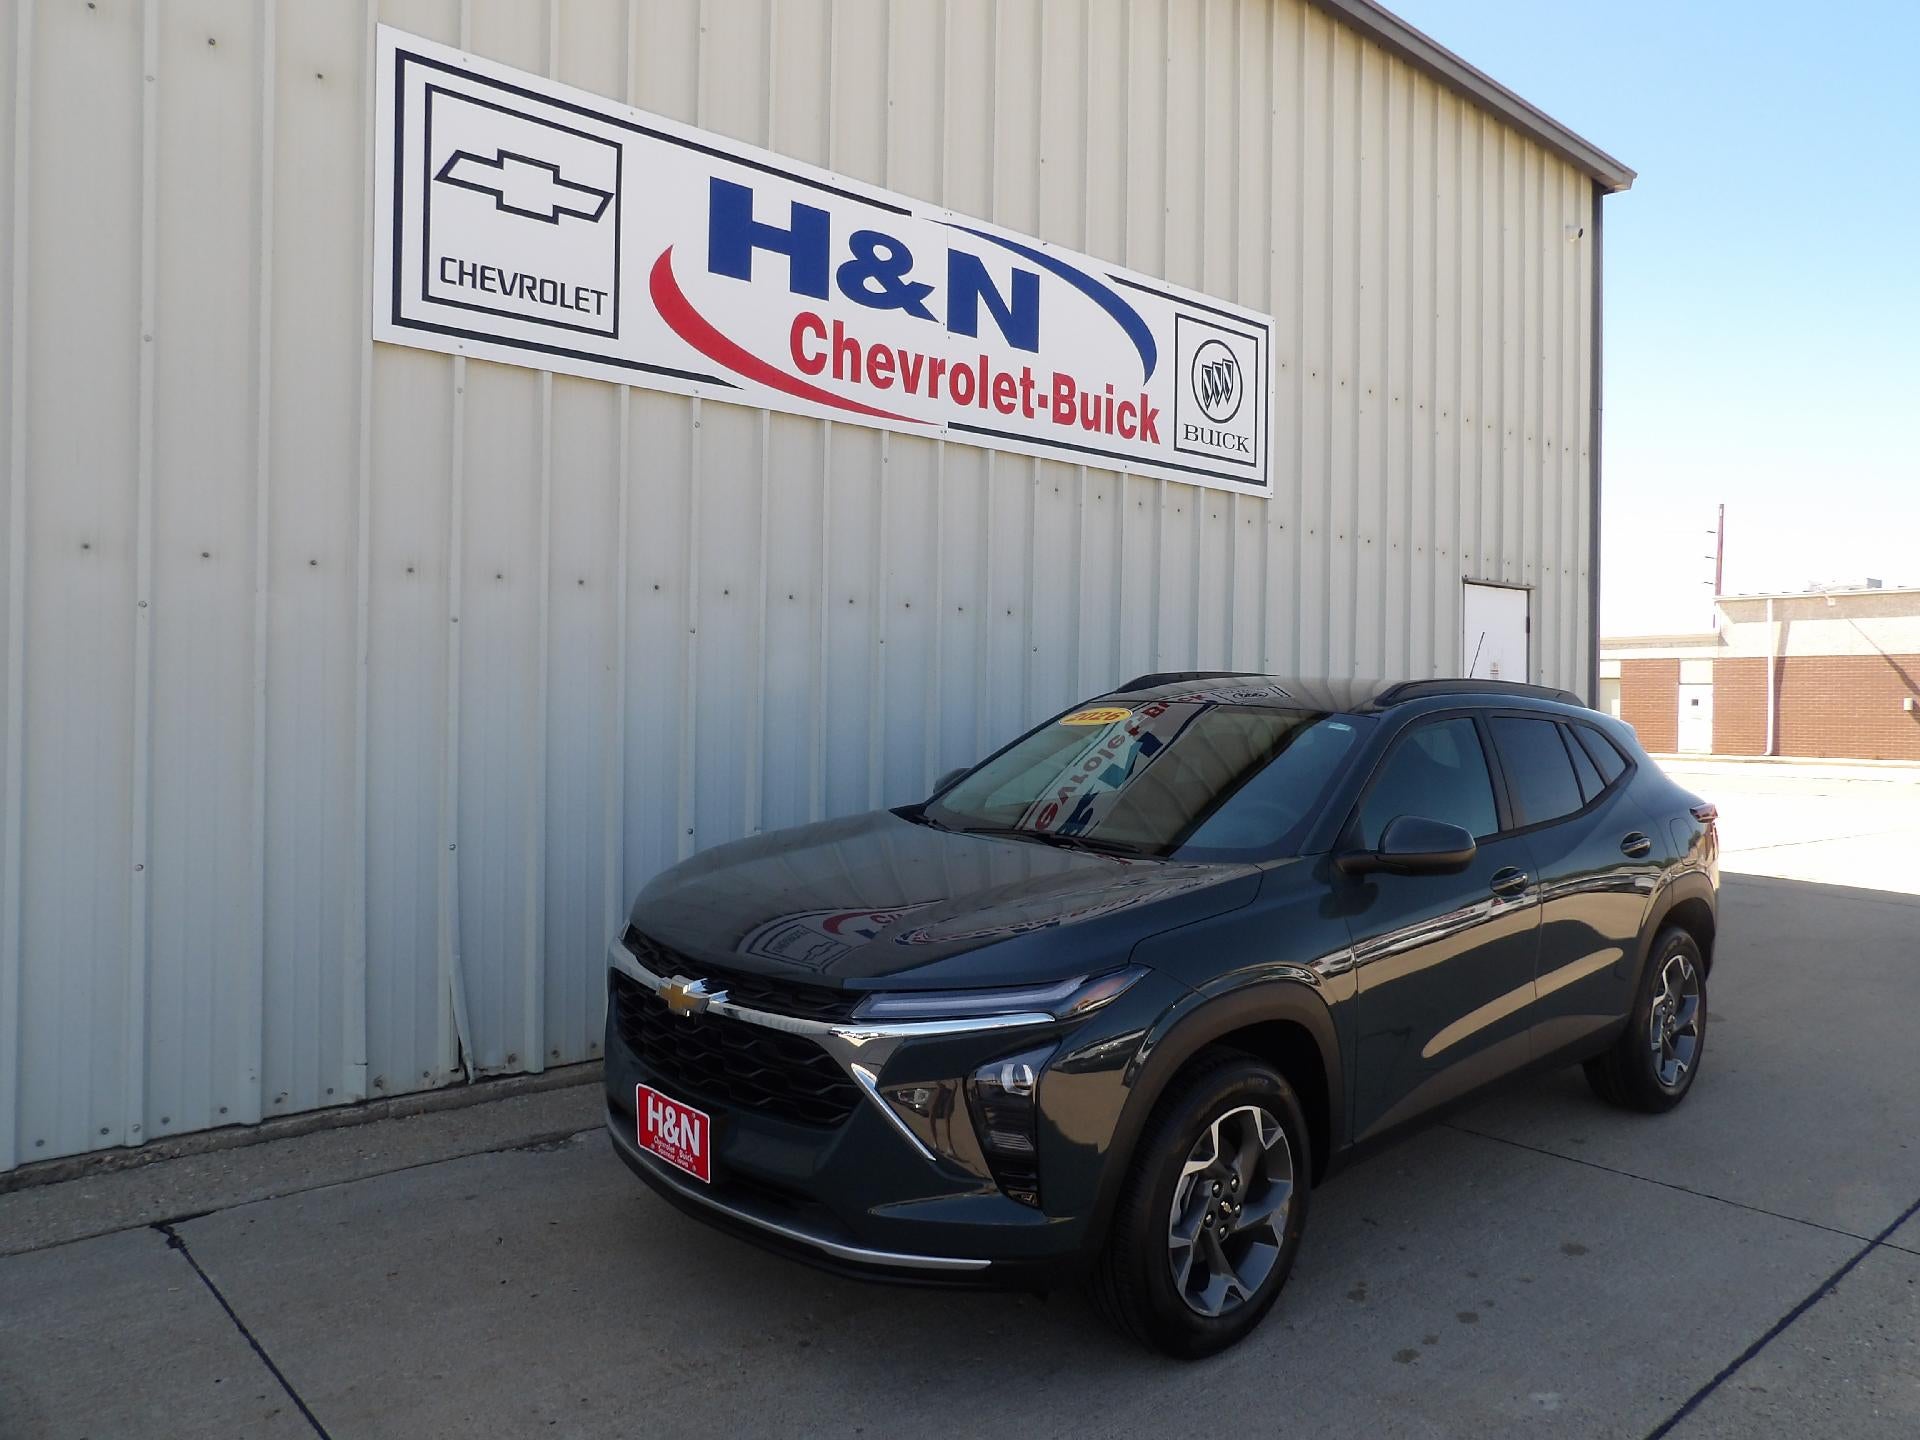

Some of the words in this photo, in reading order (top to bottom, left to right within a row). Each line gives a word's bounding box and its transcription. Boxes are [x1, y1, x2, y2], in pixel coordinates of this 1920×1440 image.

[440, 256, 607, 315] CHEVROLET
[708, 176, 1040, 353] H&N
[790, 312, 1160, 445] Chevrolet-Buick
[1183, 423, 1250, 453] BUICK
[1064, 711, 1126, 722] 2026
[648, 1096, 699, 1156] H&N
